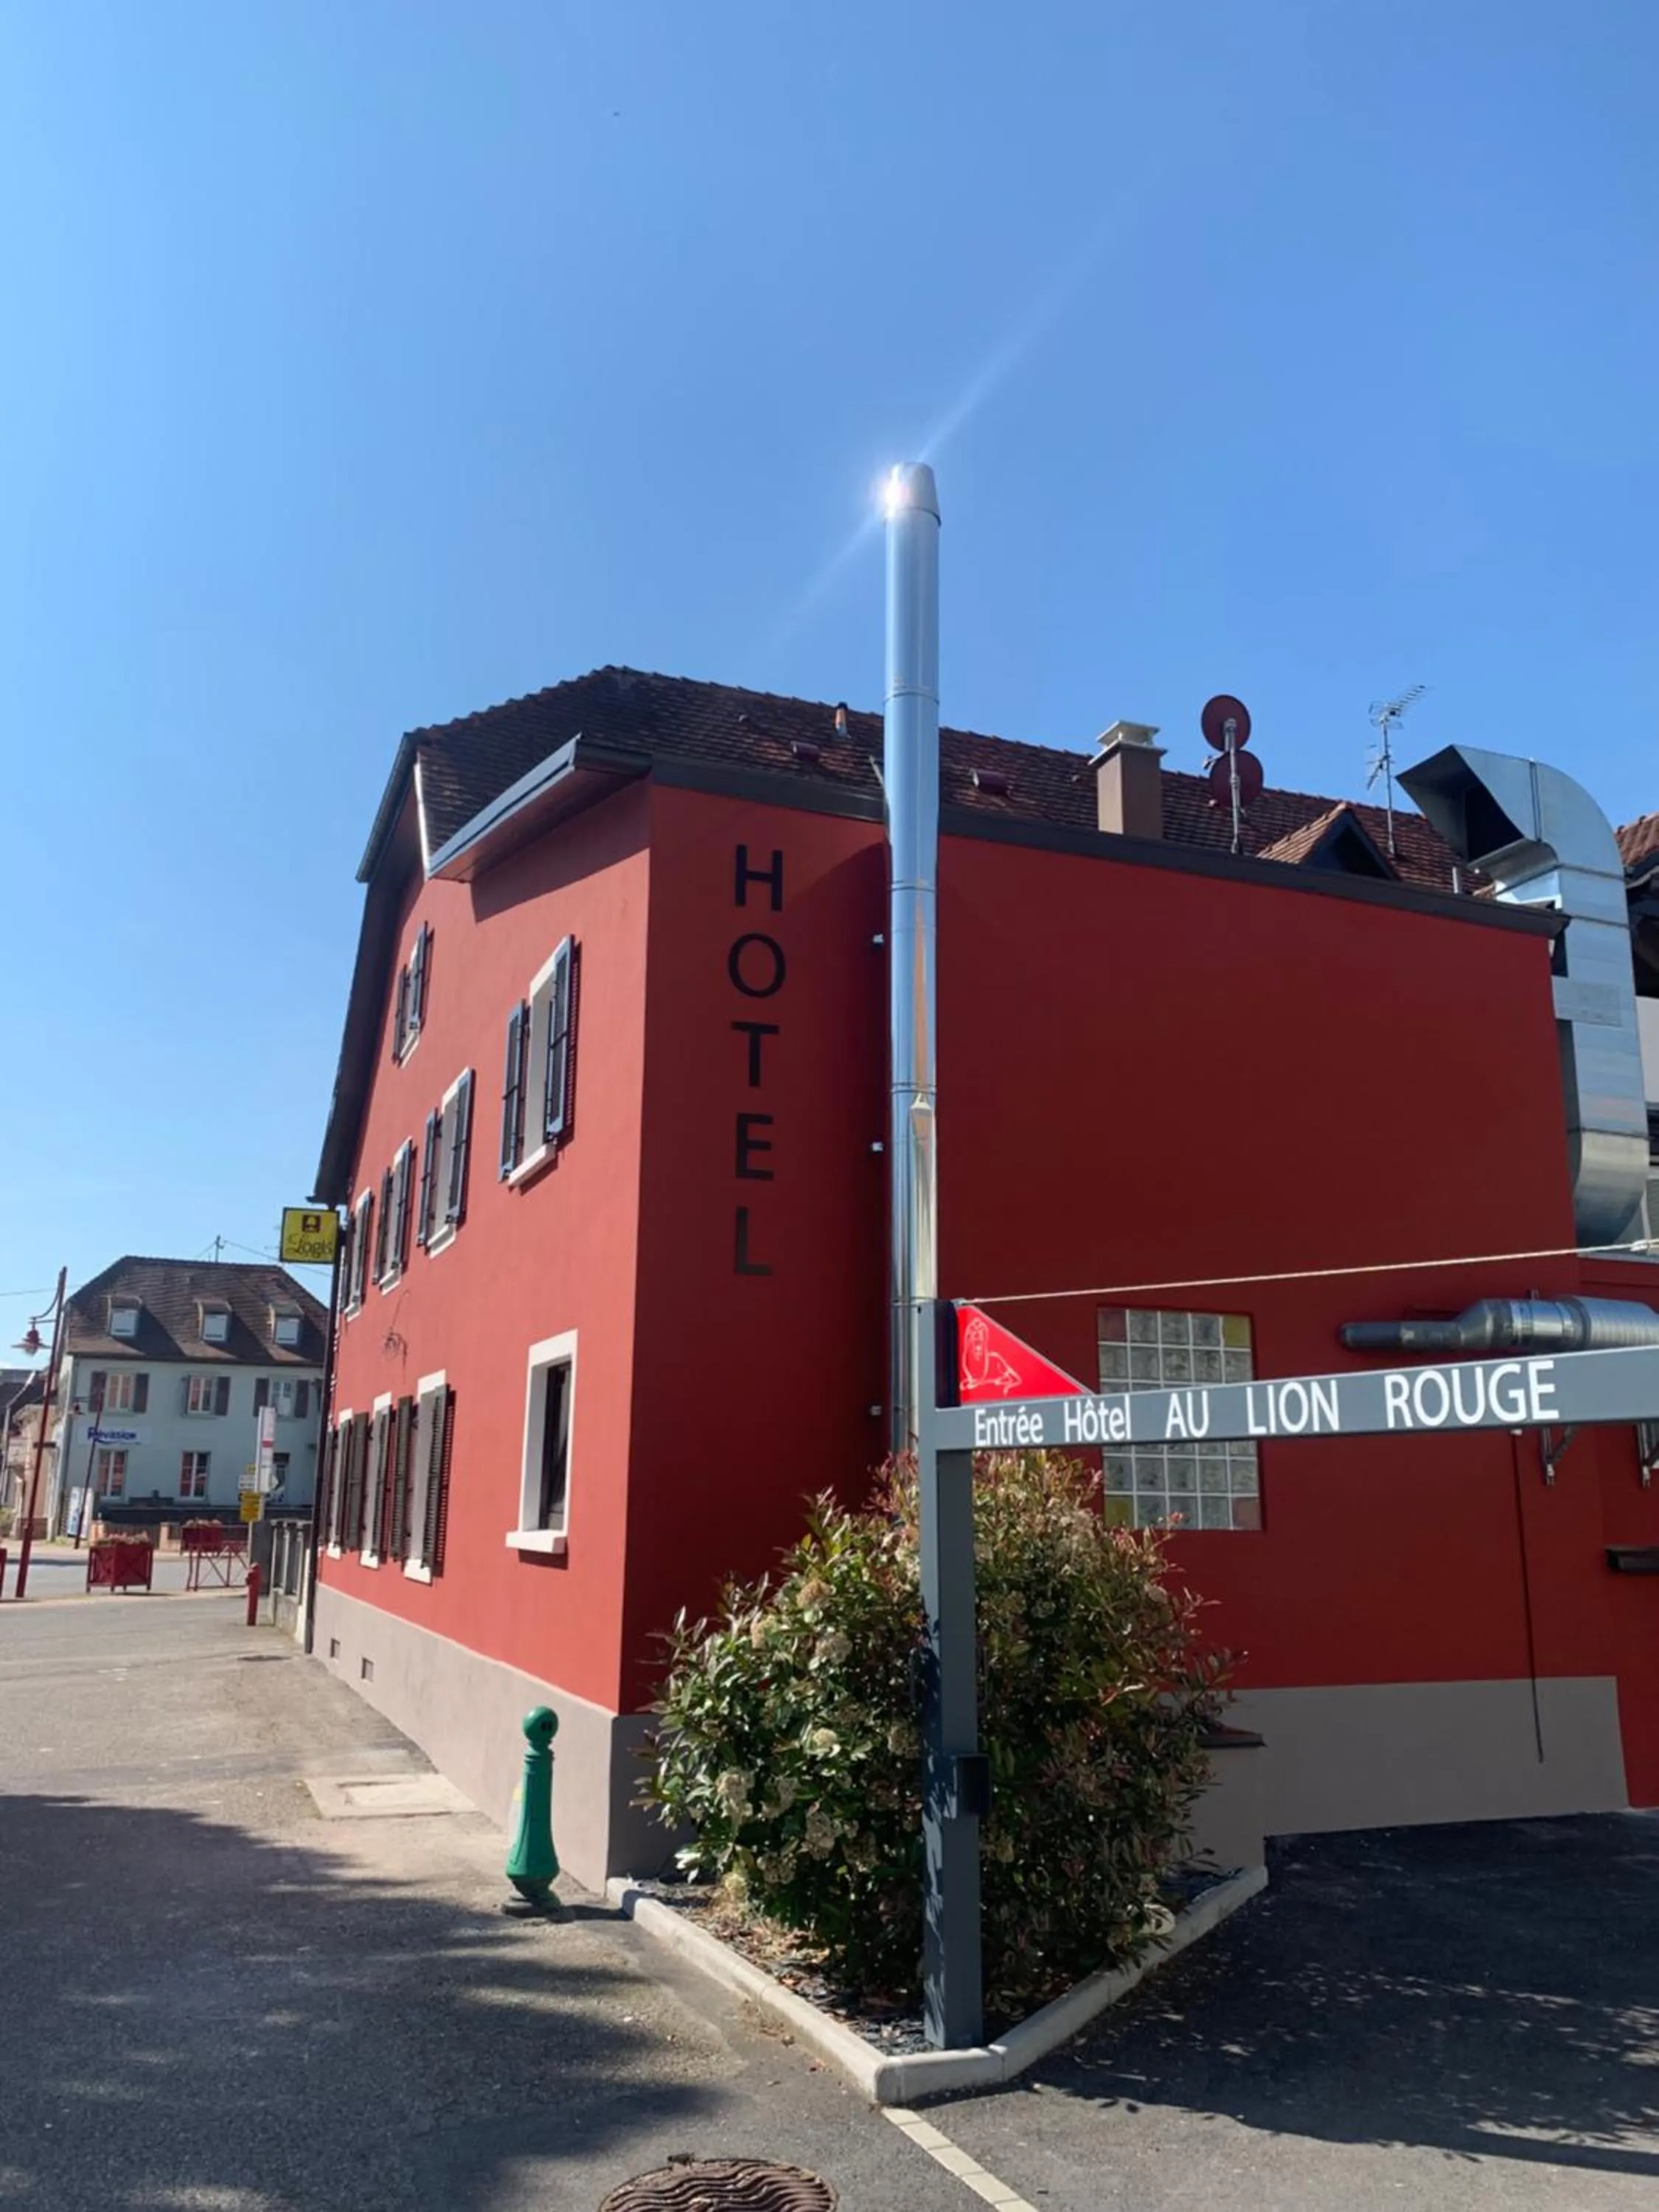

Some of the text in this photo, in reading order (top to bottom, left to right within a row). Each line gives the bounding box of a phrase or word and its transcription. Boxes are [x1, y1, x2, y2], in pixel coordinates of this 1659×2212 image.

[728, 844, 786, 1276] HOTEL
[974, 1360, 1559, 1447] Entrée Hôtel AU LION ROUGE
